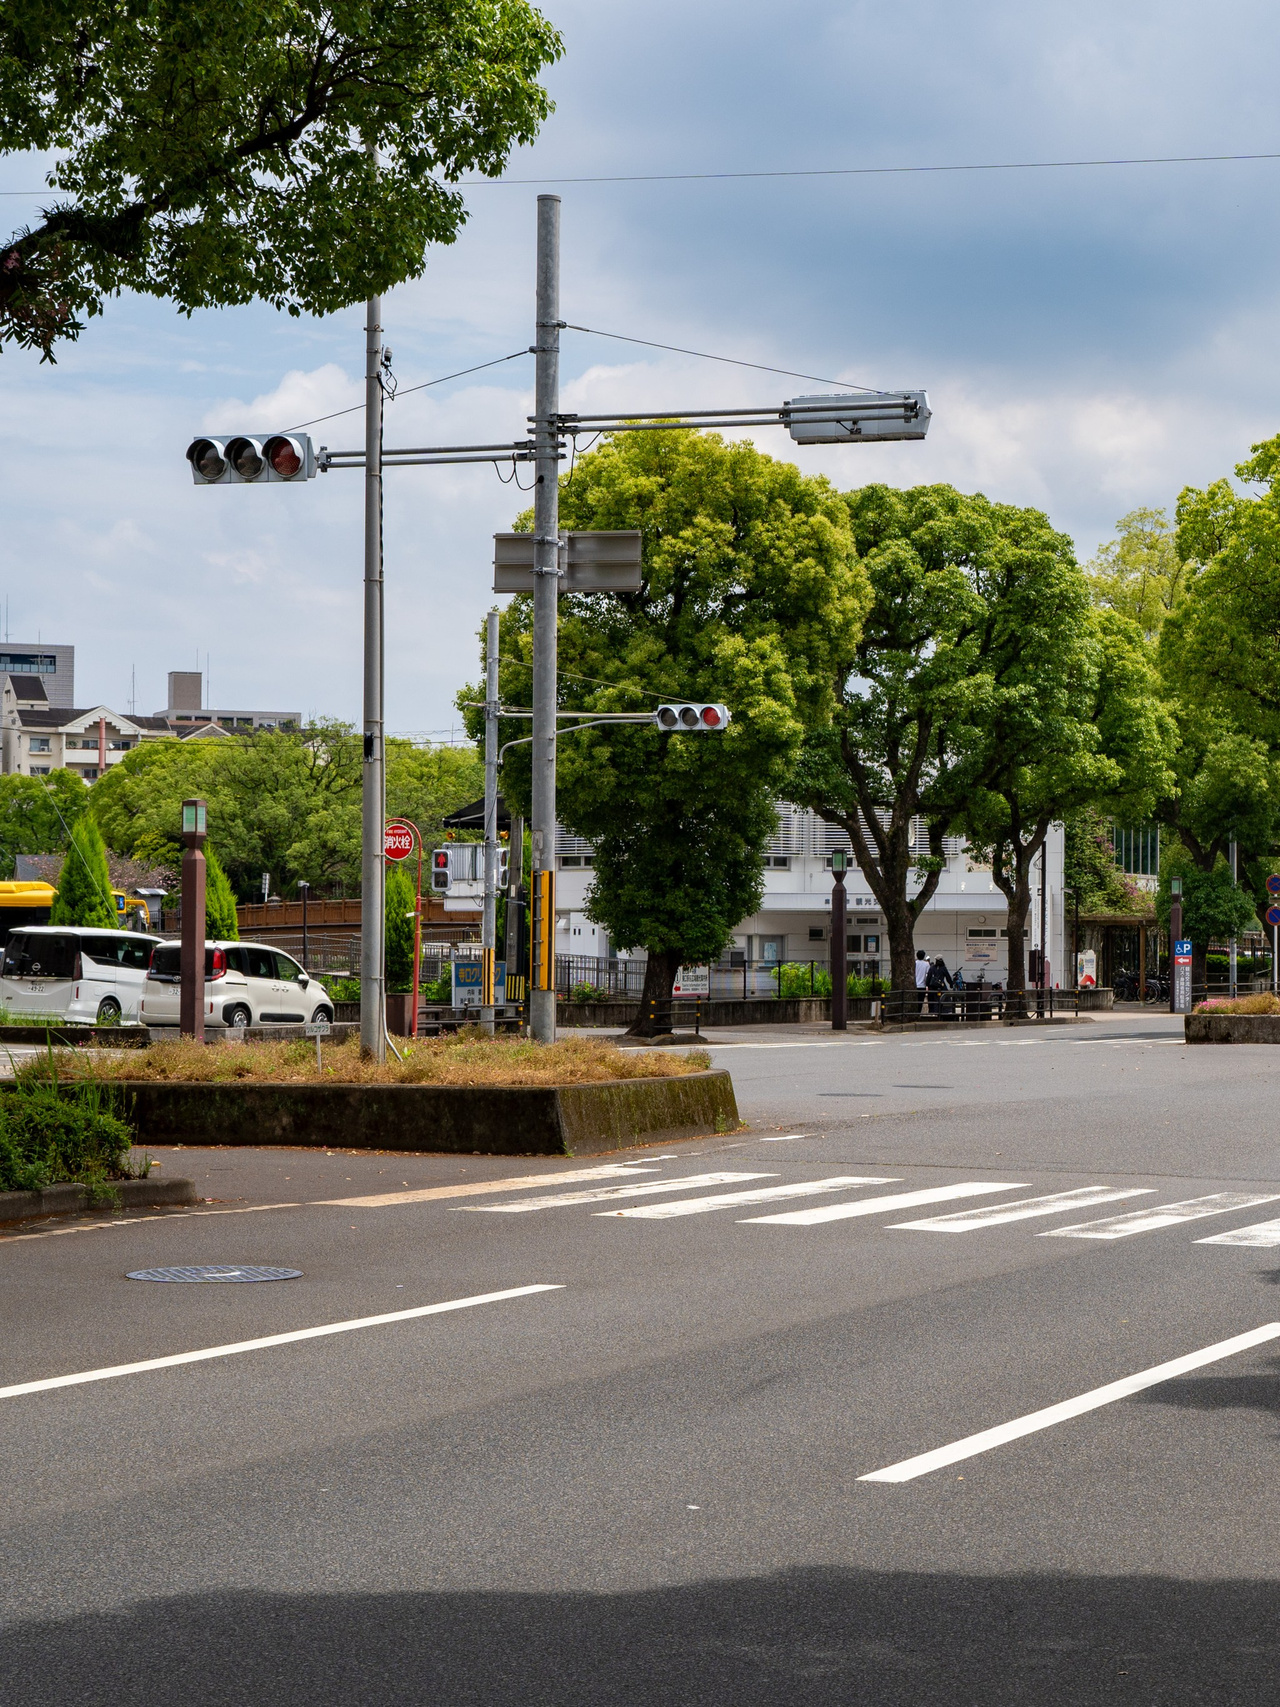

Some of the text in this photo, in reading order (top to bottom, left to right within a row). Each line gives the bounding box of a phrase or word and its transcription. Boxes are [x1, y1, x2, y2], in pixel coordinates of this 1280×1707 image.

[385, 835, 410, 849] 消火栓
[1183, 944, 1191, 953] P
[458, 967, 501, 983] 寺口クリク
